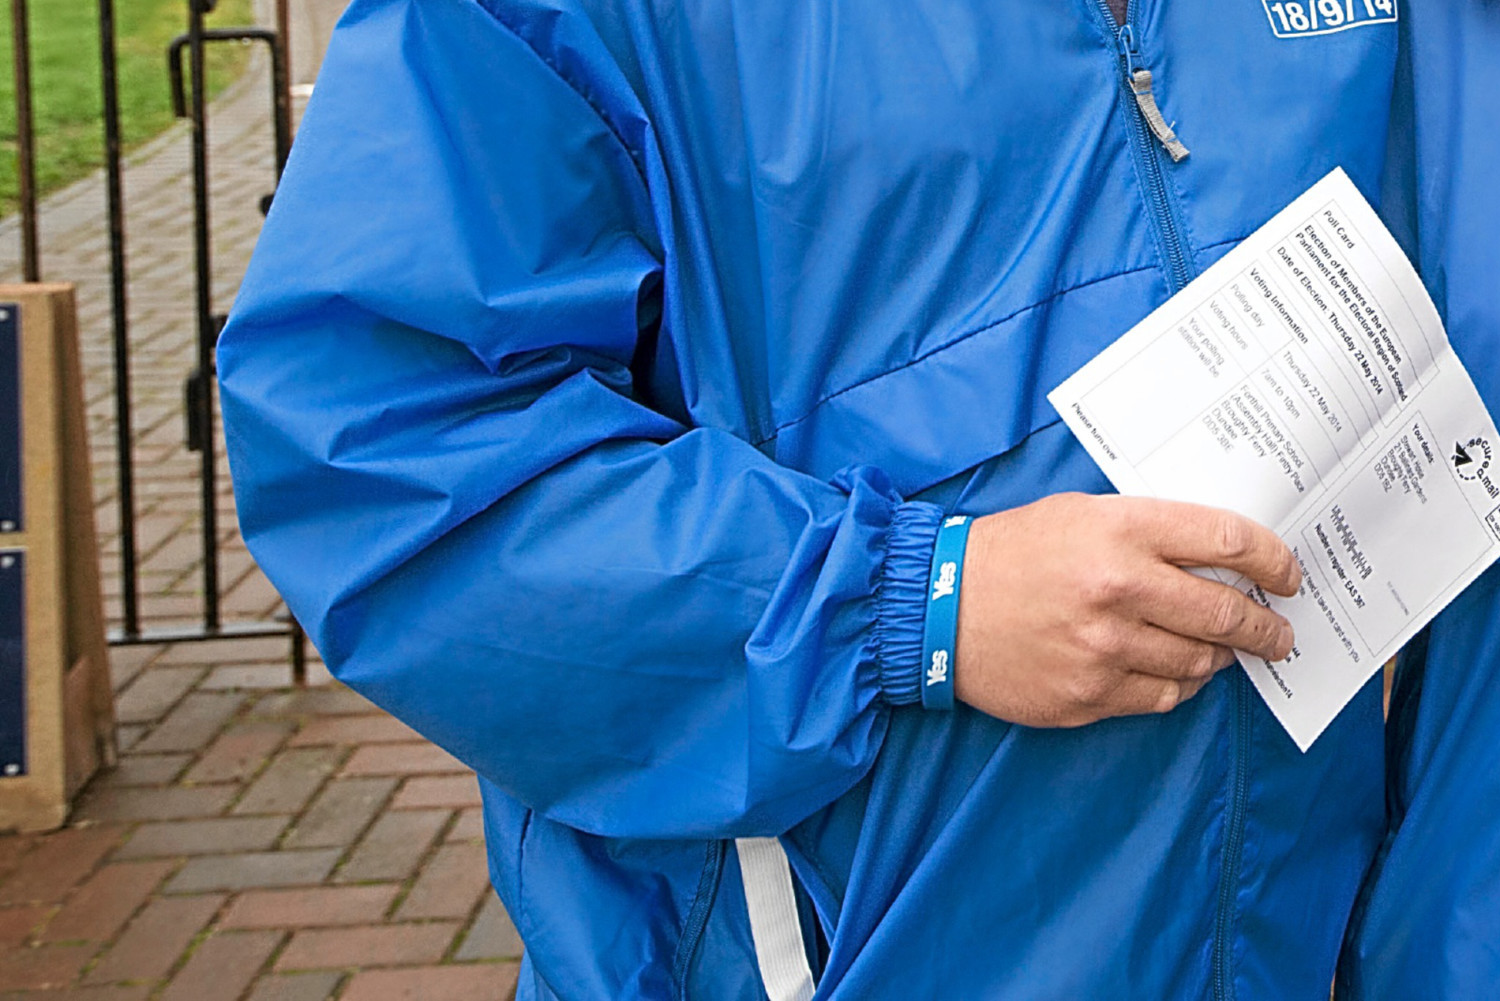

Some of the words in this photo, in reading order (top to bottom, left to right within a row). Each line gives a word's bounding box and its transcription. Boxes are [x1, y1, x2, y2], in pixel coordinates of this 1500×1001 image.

[1323, 210, 1339, 228] Poll
[1336, 227, 1354, 248] Card
[1230, 283, 1252, 312] Polling
[1250, 311, 1264, 327] day
[1250, 267, 1272, 298] Voting
[1270, 295, 1308, 343] Information
[1295, 232, 1331, 277] Parliament
[1328, 275, 1340, 288] for
[1338, 288, 1350, 303] the
[1348, 302, 1375, 338] Electoral
[1372, 336, 1389, 365] Region
[1387, 364, 1395, 372] of
[1304, 224, 1331, 259] Election
[1330, 259, 1341, 268] of
[1337, 267, 1366, 306] Members
[1364, 306, 1375, 315] of
[1370, 314, 1381, 329] the
[1379, 327, 1401, 364] European
[1177, 326, 1200, 352] station
[1188, 317, 1204, 337] Your
[1200, 337, 1224, 365] polling
[1209, 300, 1230, 328] Voting
[1227, 325, 1248, 349] hours
[1277, 246, 1294, 267] Date
[1292, 267, 1303, 276] of
[1328, 311, 1356, 351] Thursday
[1353, 349, 1364, 362] 22
[1360, 359, 1372, 377] May
[1369, 375, 1383, 394] 2014
[1283, 350, 1311, 388] Thursday
[1308, 386, 1320, 397] 22
[1317, 396, 1329, 414] May
[1327, 413, 1341, 432] 2014
[1071, 402, 1092, 428] Please
[1211, 407, 1237, 439] Dundee
[1221, 399, 1250, 435] Broughty
[1248, 434, 1266, 457] Ferry
[1240, 384, 1263, 413] Forthill
[1260, 411, 1285, 442] Primary
[1282, 440, 1304, 468] School
[1412, 423, 1423, 441] Your
[1290, 471, 1304, 493] Place
[1380, 455, 1395, 482] Dundee
[1387, 448, 1403, 478] Broughty
[1400, 474, 1411, 494] Ferry
[932, 561, 957, 600] Yes
[1314, 523, 1329, 548] Number
[1326, 548, 1333, 557] on
[1344, 579, 1357, 597] EAS
[1306, 575, 1317, 592] need
[1317, 596, 1328, 611] take
[1325, 609, 1335, 623] this
[1332, 622, 1344, 637] card
[1341, 636, 1352, 650] with
[1348, 648, 1359, 663] you
[927, 649, 948, 686] Yes
